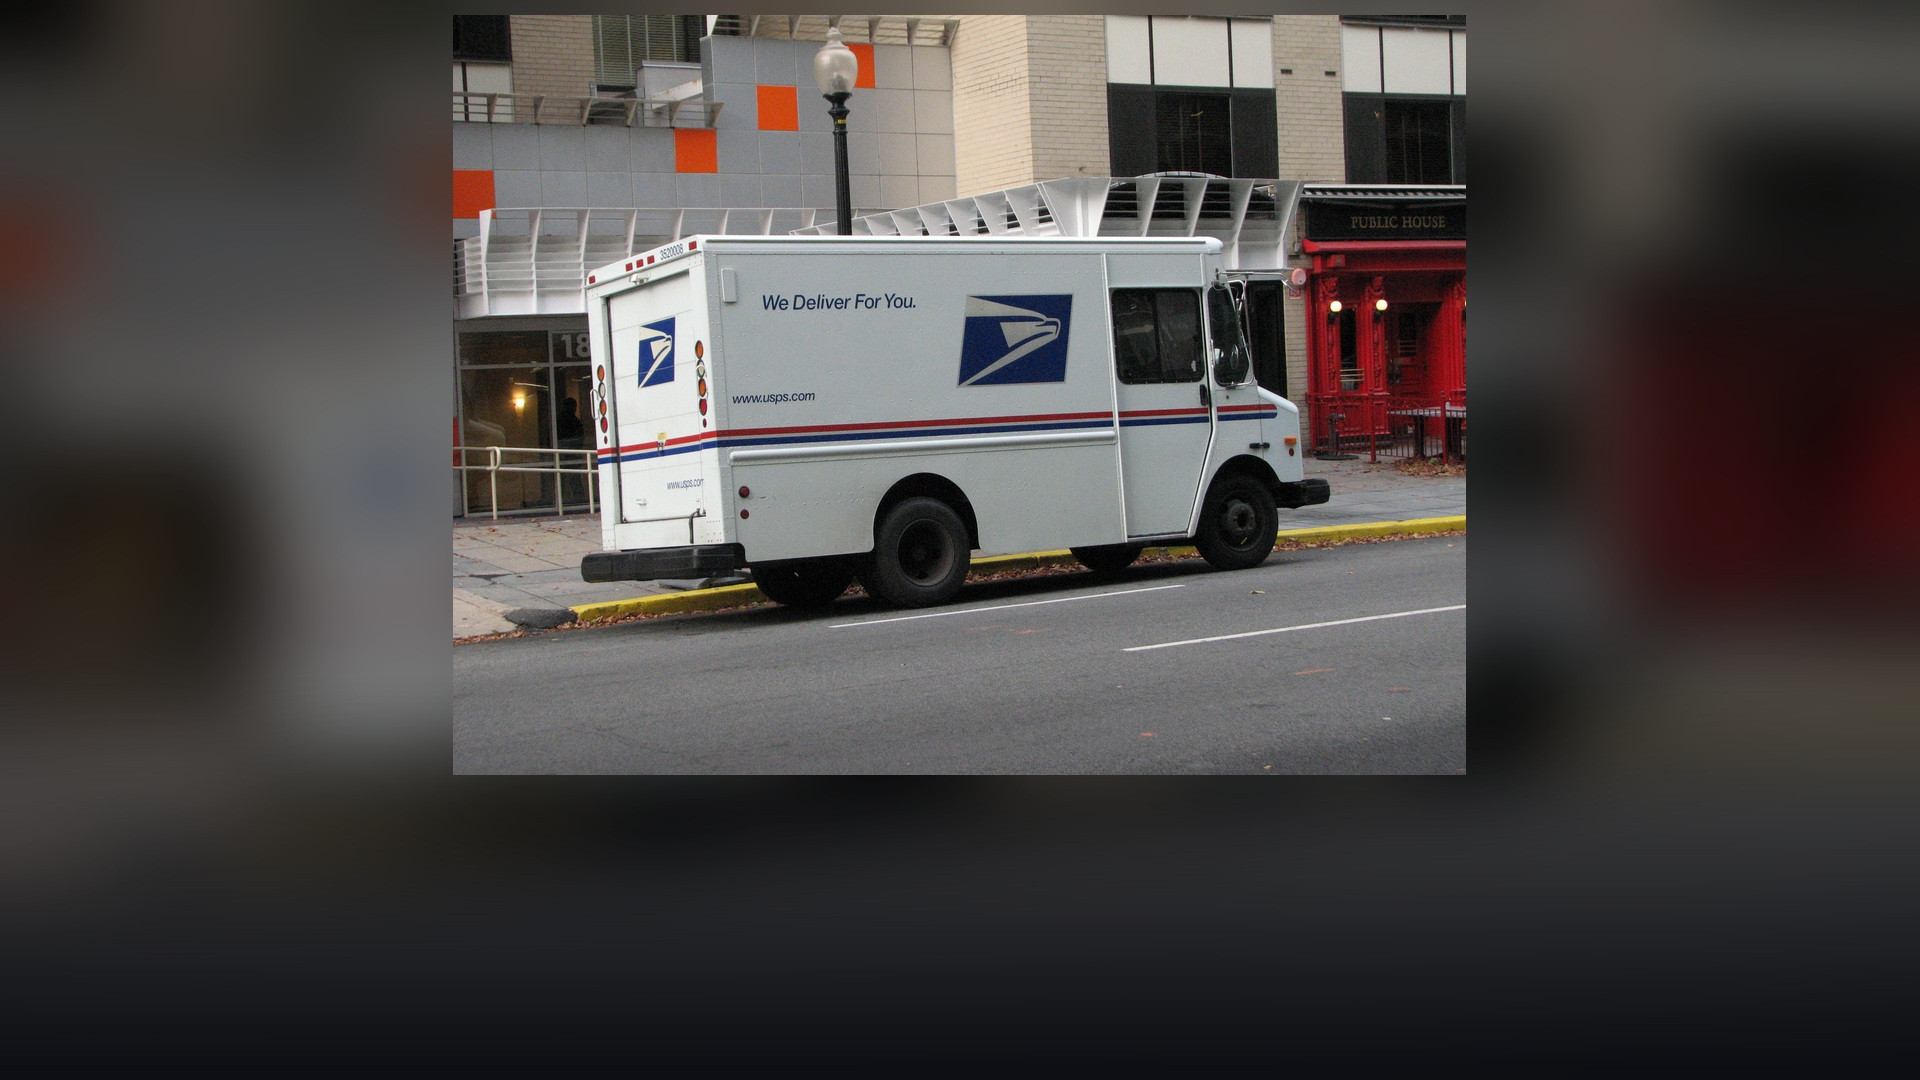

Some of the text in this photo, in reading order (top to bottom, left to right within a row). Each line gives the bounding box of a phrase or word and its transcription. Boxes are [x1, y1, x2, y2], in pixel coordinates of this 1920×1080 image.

[1351, 215, 1446, 228] PUBLIC HOUSE
[660, 243, 684, 260] 3520008
[762, 293, 916, 311] We Deliver For You.
[732, 392, 815, 405] www.usps.com
